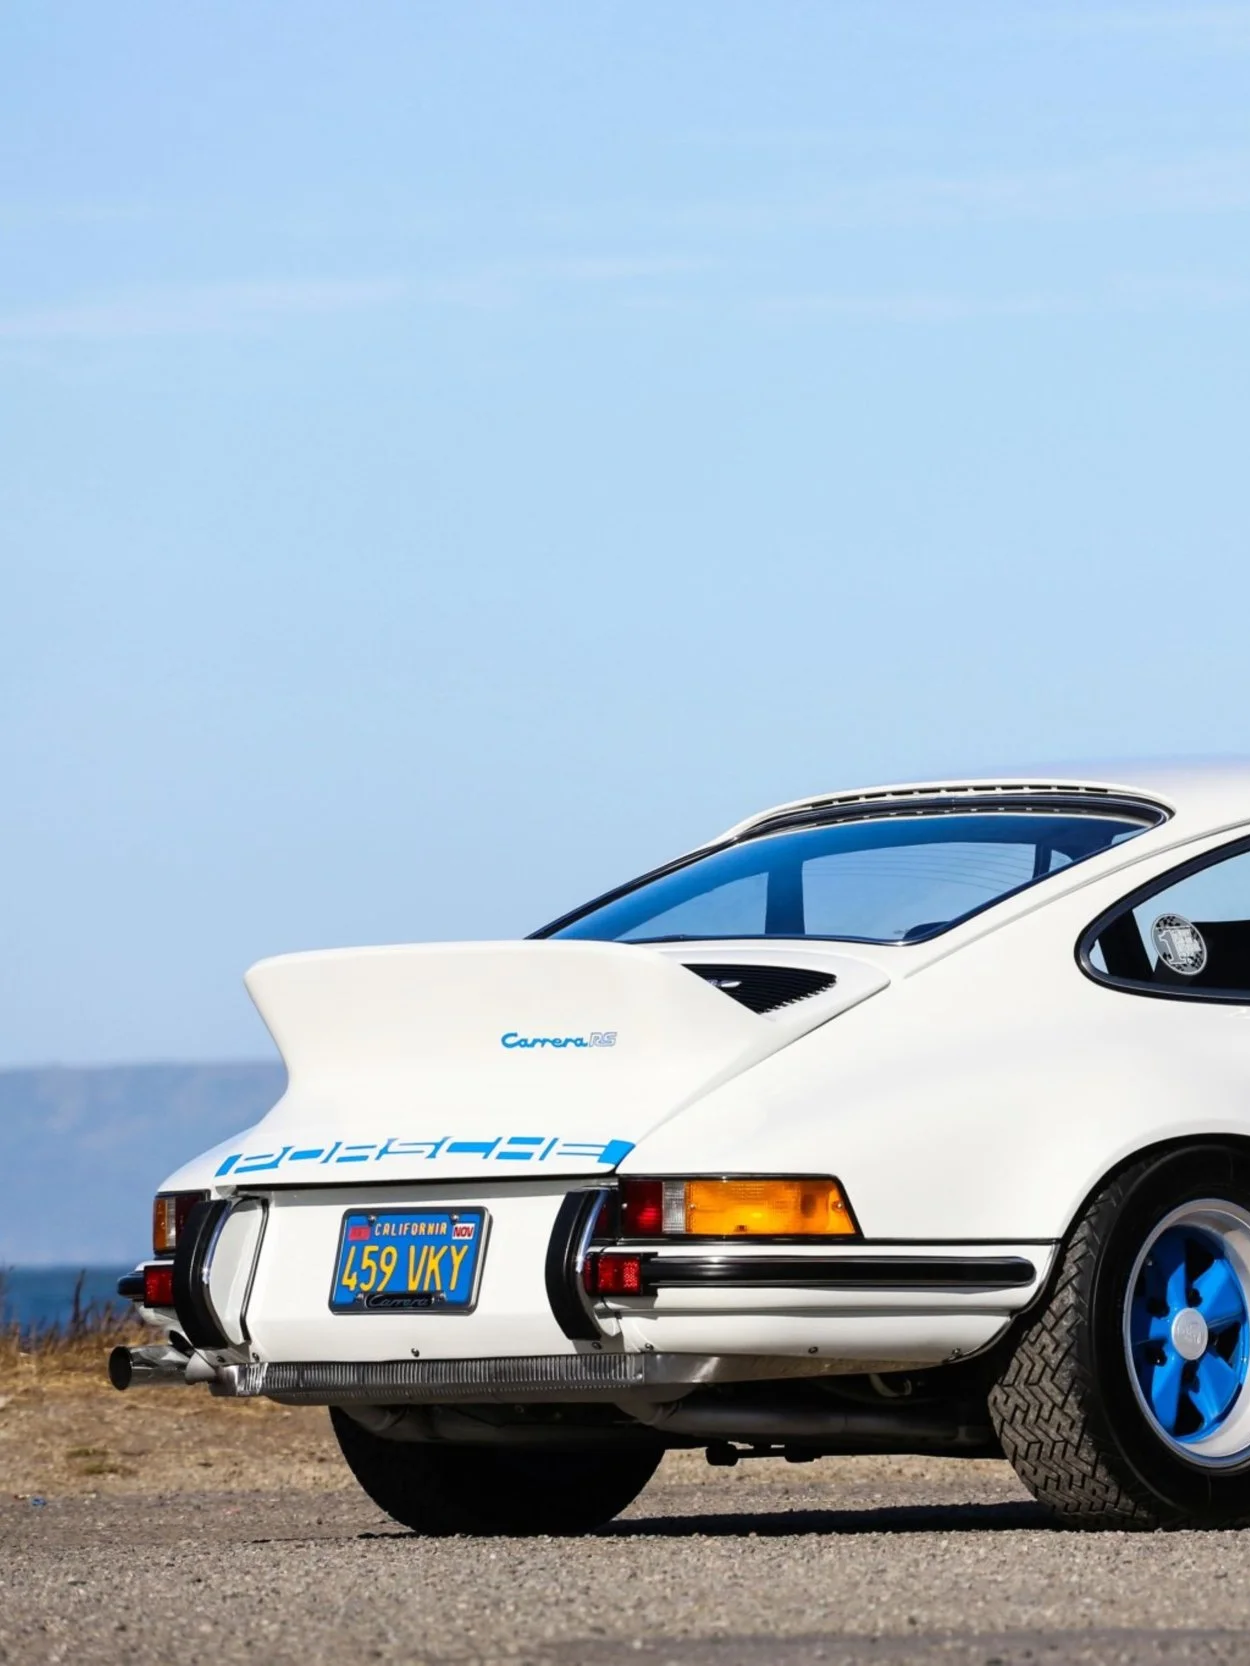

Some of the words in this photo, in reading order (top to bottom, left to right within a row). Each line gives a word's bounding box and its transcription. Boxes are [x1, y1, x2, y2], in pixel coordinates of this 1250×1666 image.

[215, 1136, 612, 1178] PORSCHE
[374, 1222, 447, 1236] CALIFORNIA
[453, 1226, 475, 1238] NOV
[341, 1245, 398, 1292] 459
[407, 1245, 469, 1292] VKY
[368, 1294, 428, 1307] Carrera
